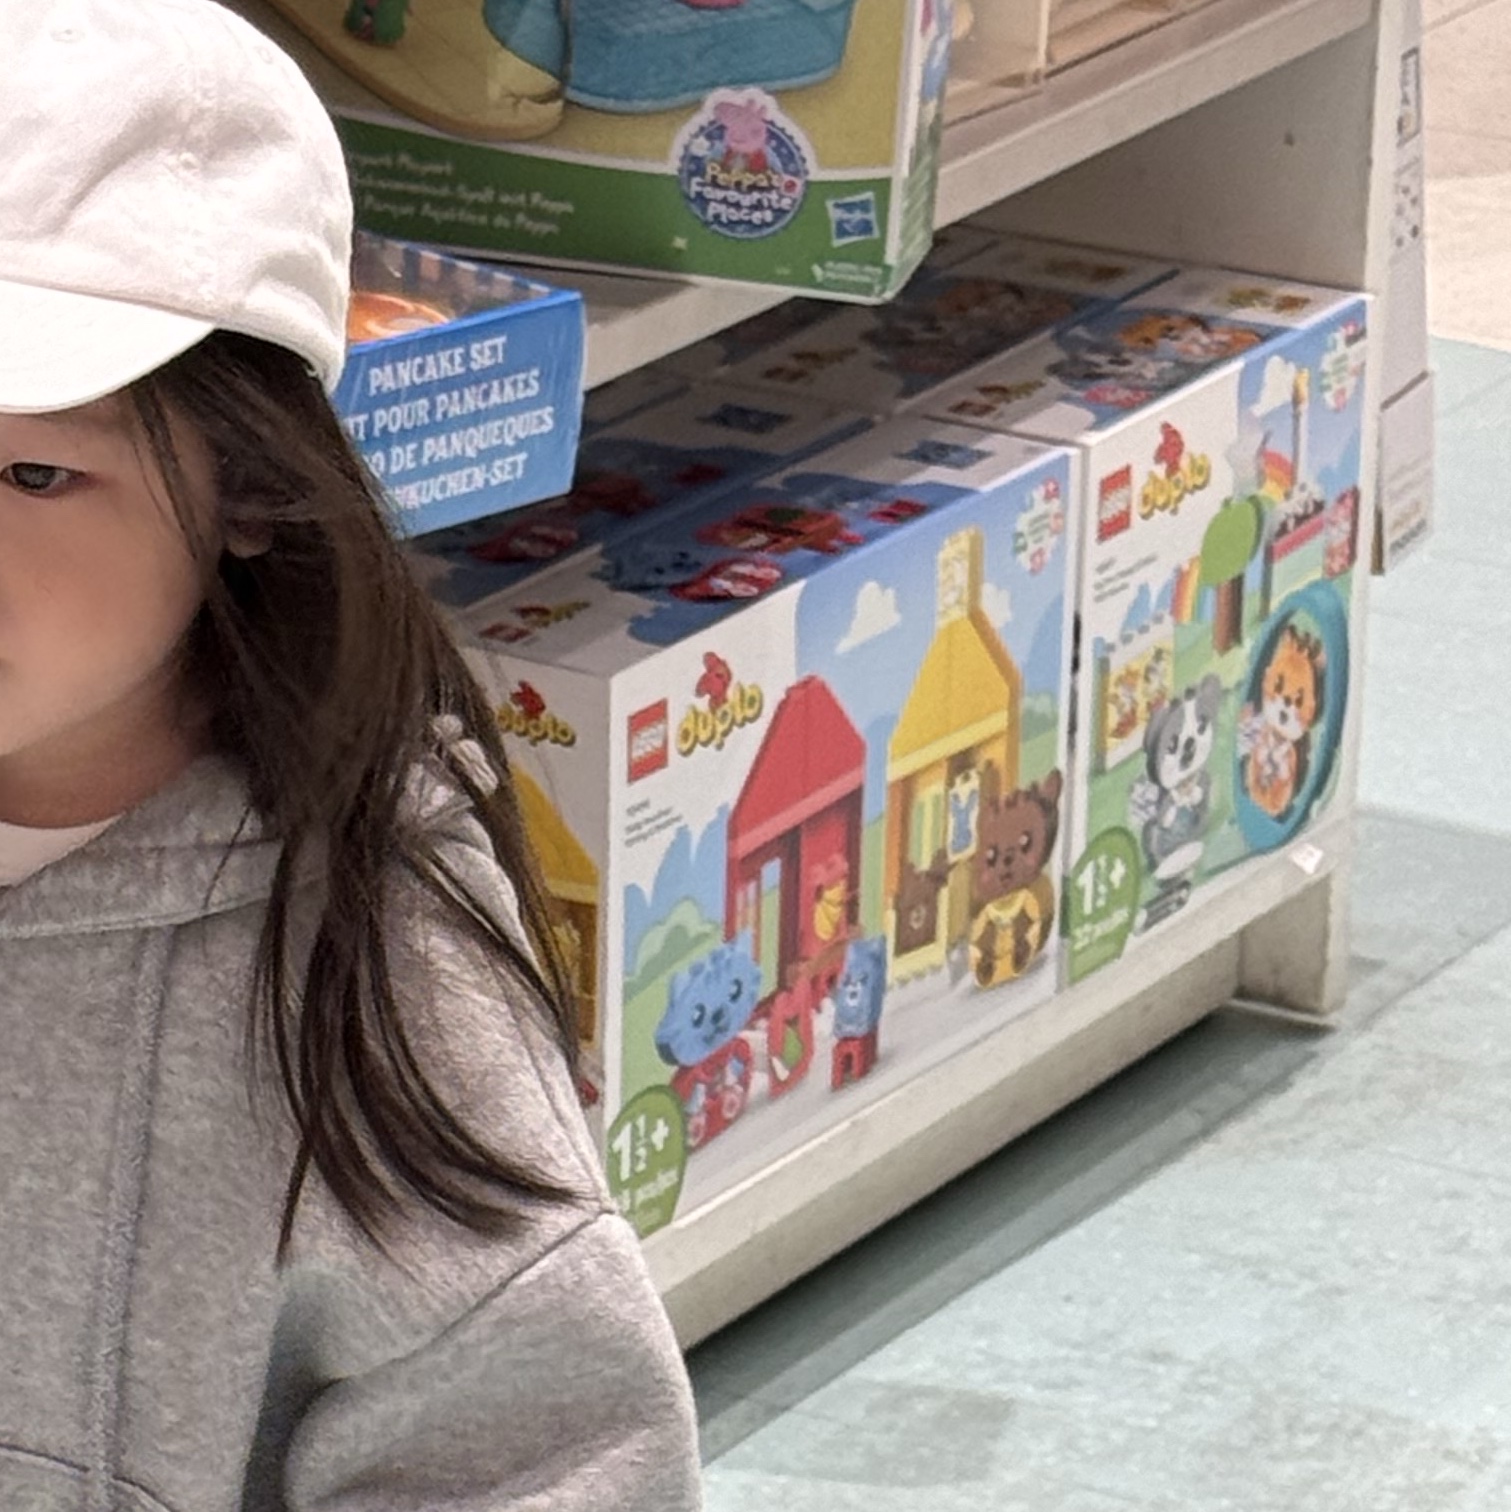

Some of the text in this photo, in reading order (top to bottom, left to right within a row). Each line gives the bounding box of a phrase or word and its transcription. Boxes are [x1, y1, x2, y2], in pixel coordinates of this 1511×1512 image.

[690, 177, 794, 211] Favourite
[706, 202, 774, 225] Places
[369, 335, 507, 397] PANCAKE SET
[373, 397, 430, 437] POUR
[435, 368, 540, 422] PANCAKES
[390, 443, 418, 474] DE
[422, 406, 554, 466] PANQUEQUES
[676, 681, 763, 757] duplo
